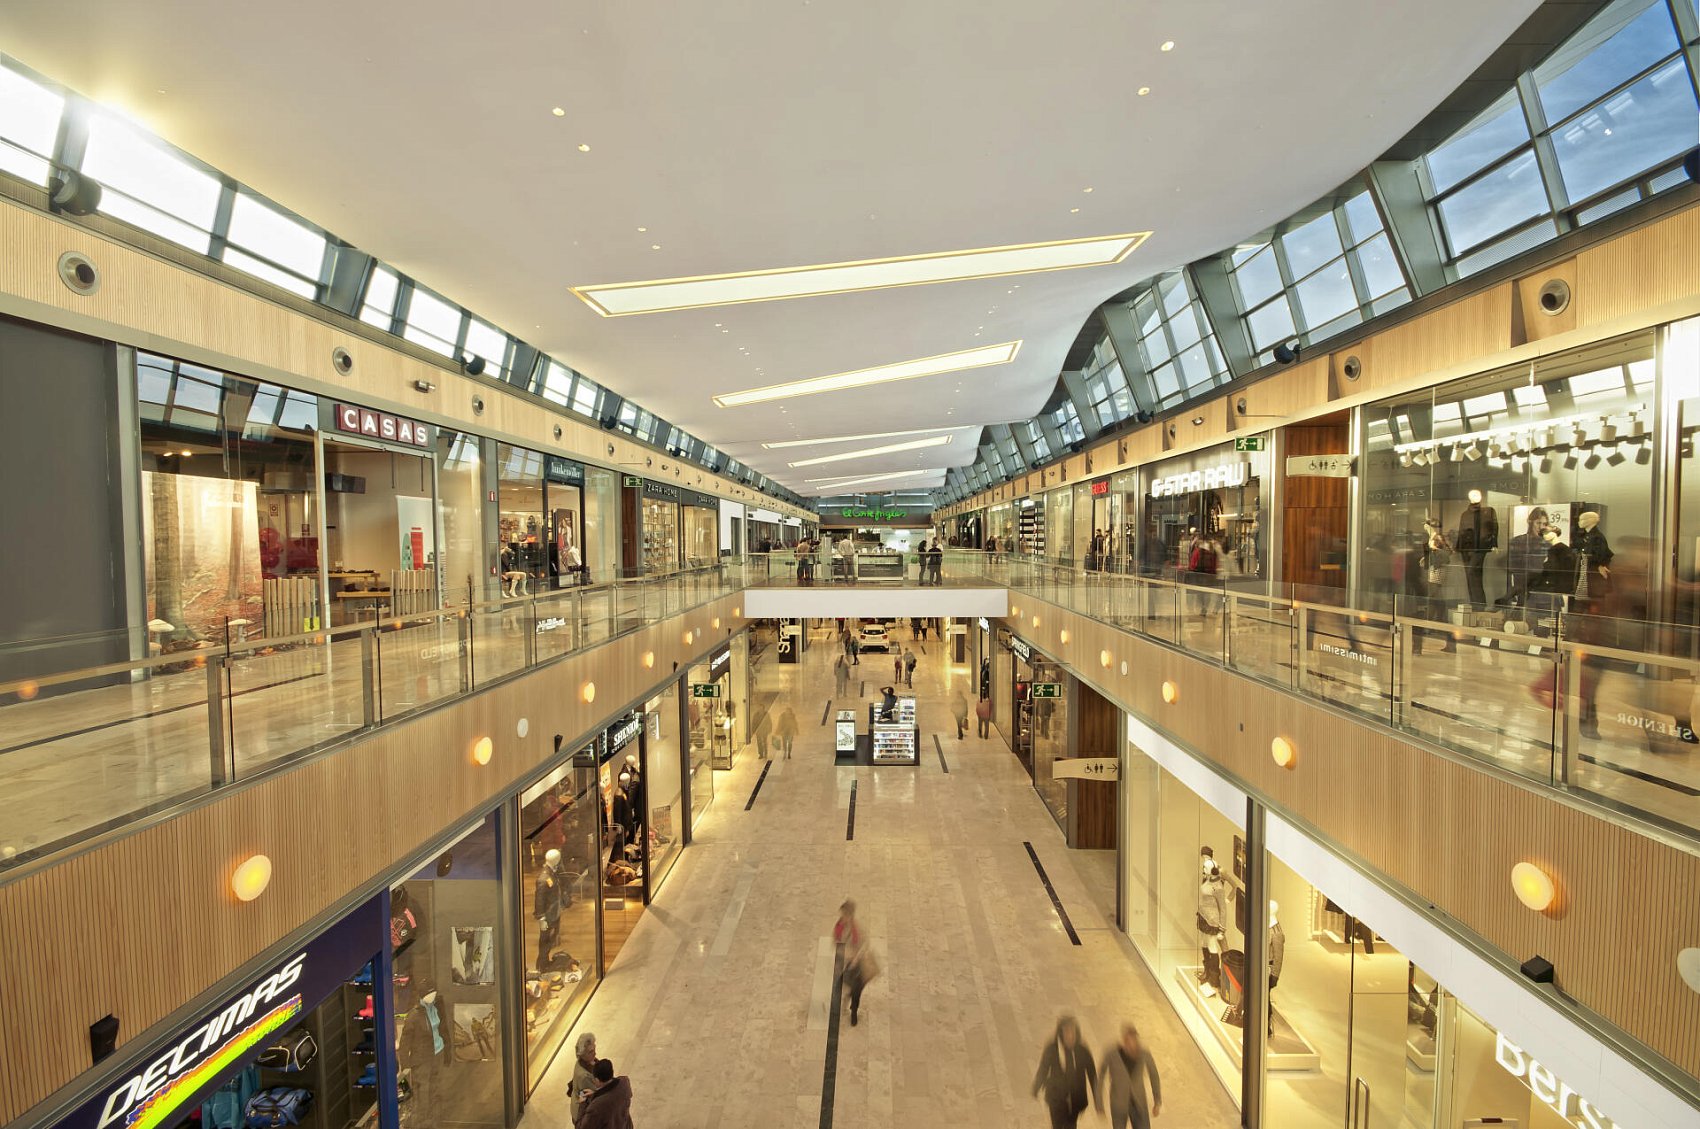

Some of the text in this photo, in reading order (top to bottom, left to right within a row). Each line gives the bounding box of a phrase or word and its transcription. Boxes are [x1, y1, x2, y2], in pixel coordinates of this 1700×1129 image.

[344, 409, 427, 443] CASAS
[1151, 470, 1201, 498] G-STAR
[97, 952, 307, 1129] DECIMAS
[1496, 1031, 1623, 1129] Bers
